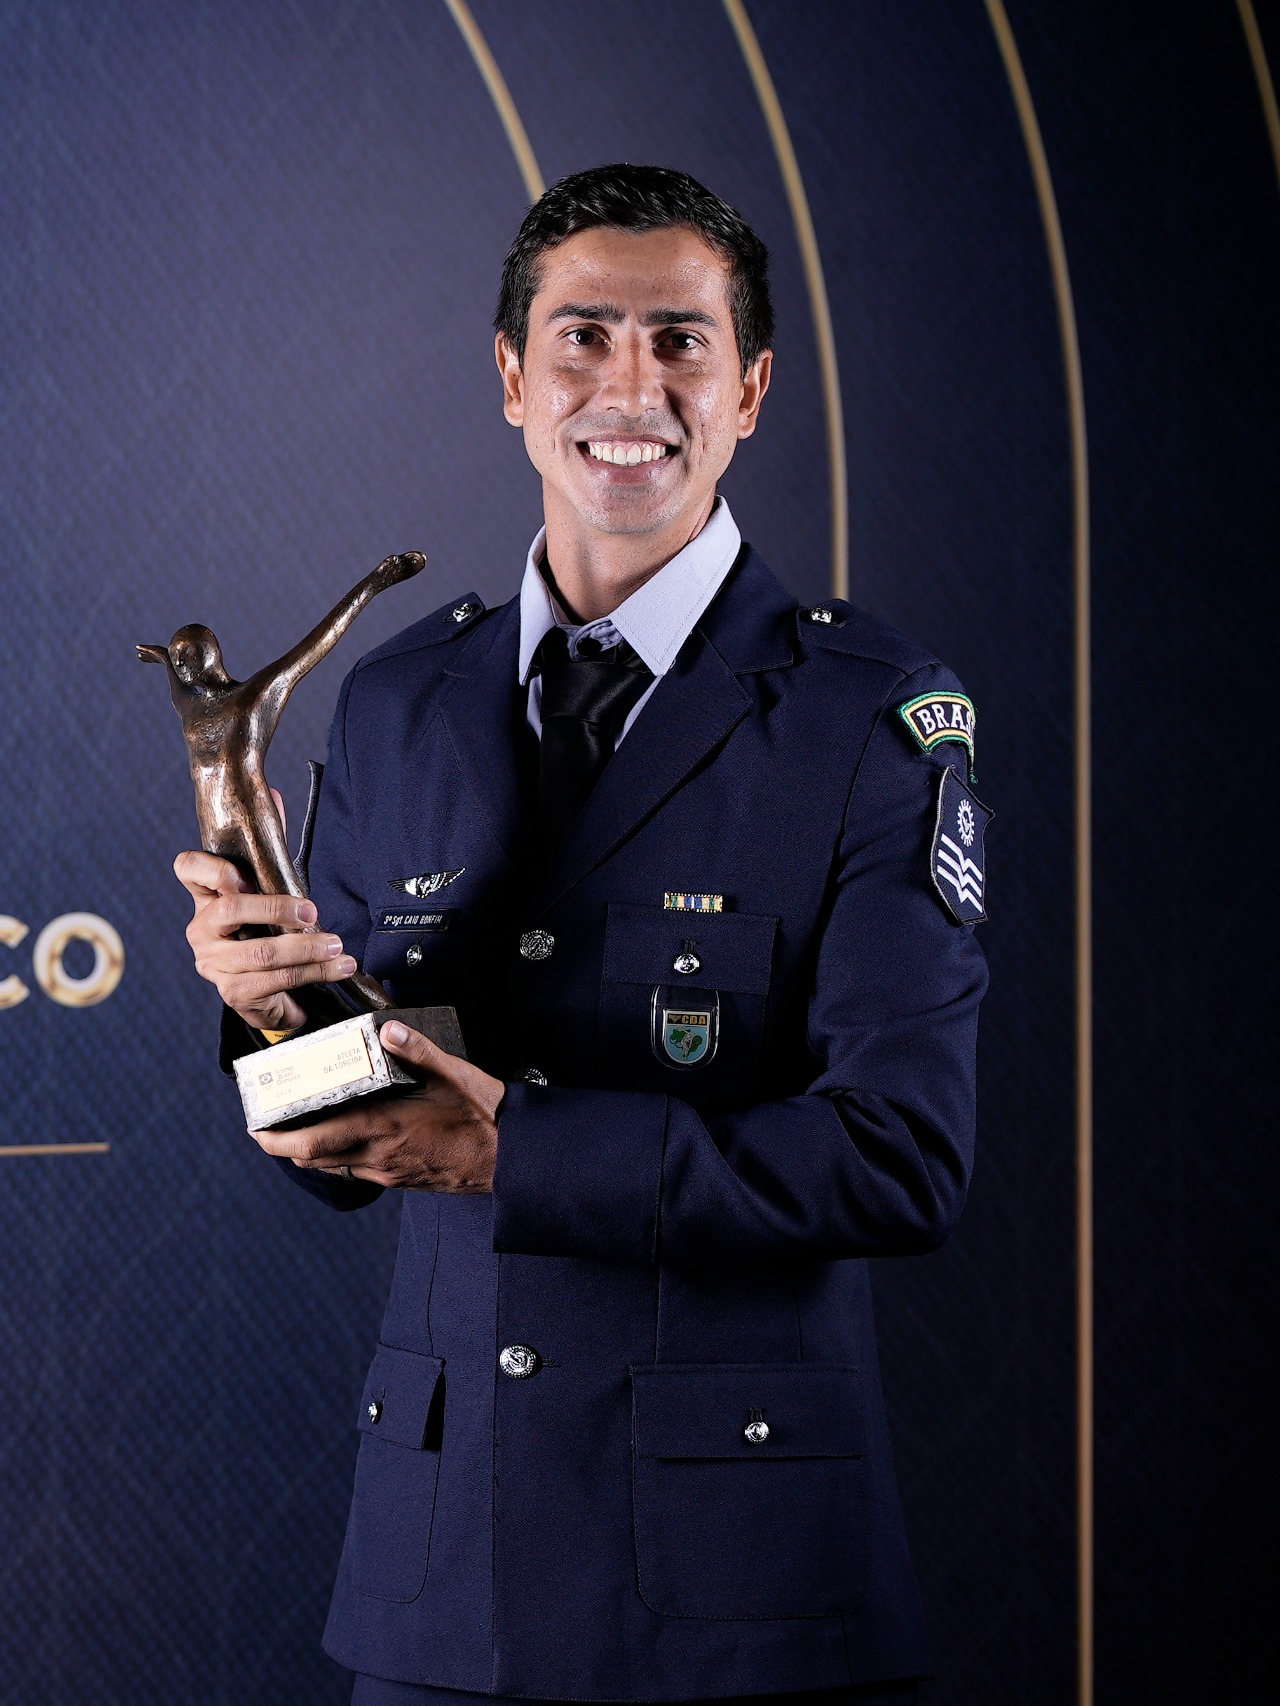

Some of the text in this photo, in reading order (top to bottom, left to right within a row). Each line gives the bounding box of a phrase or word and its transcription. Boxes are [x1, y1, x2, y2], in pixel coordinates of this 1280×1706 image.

[404, 915, 420, 925] CAIO
[681, 1014, 706, 1025] CDA
[336, 1047, 362, 1061] ATLETA
